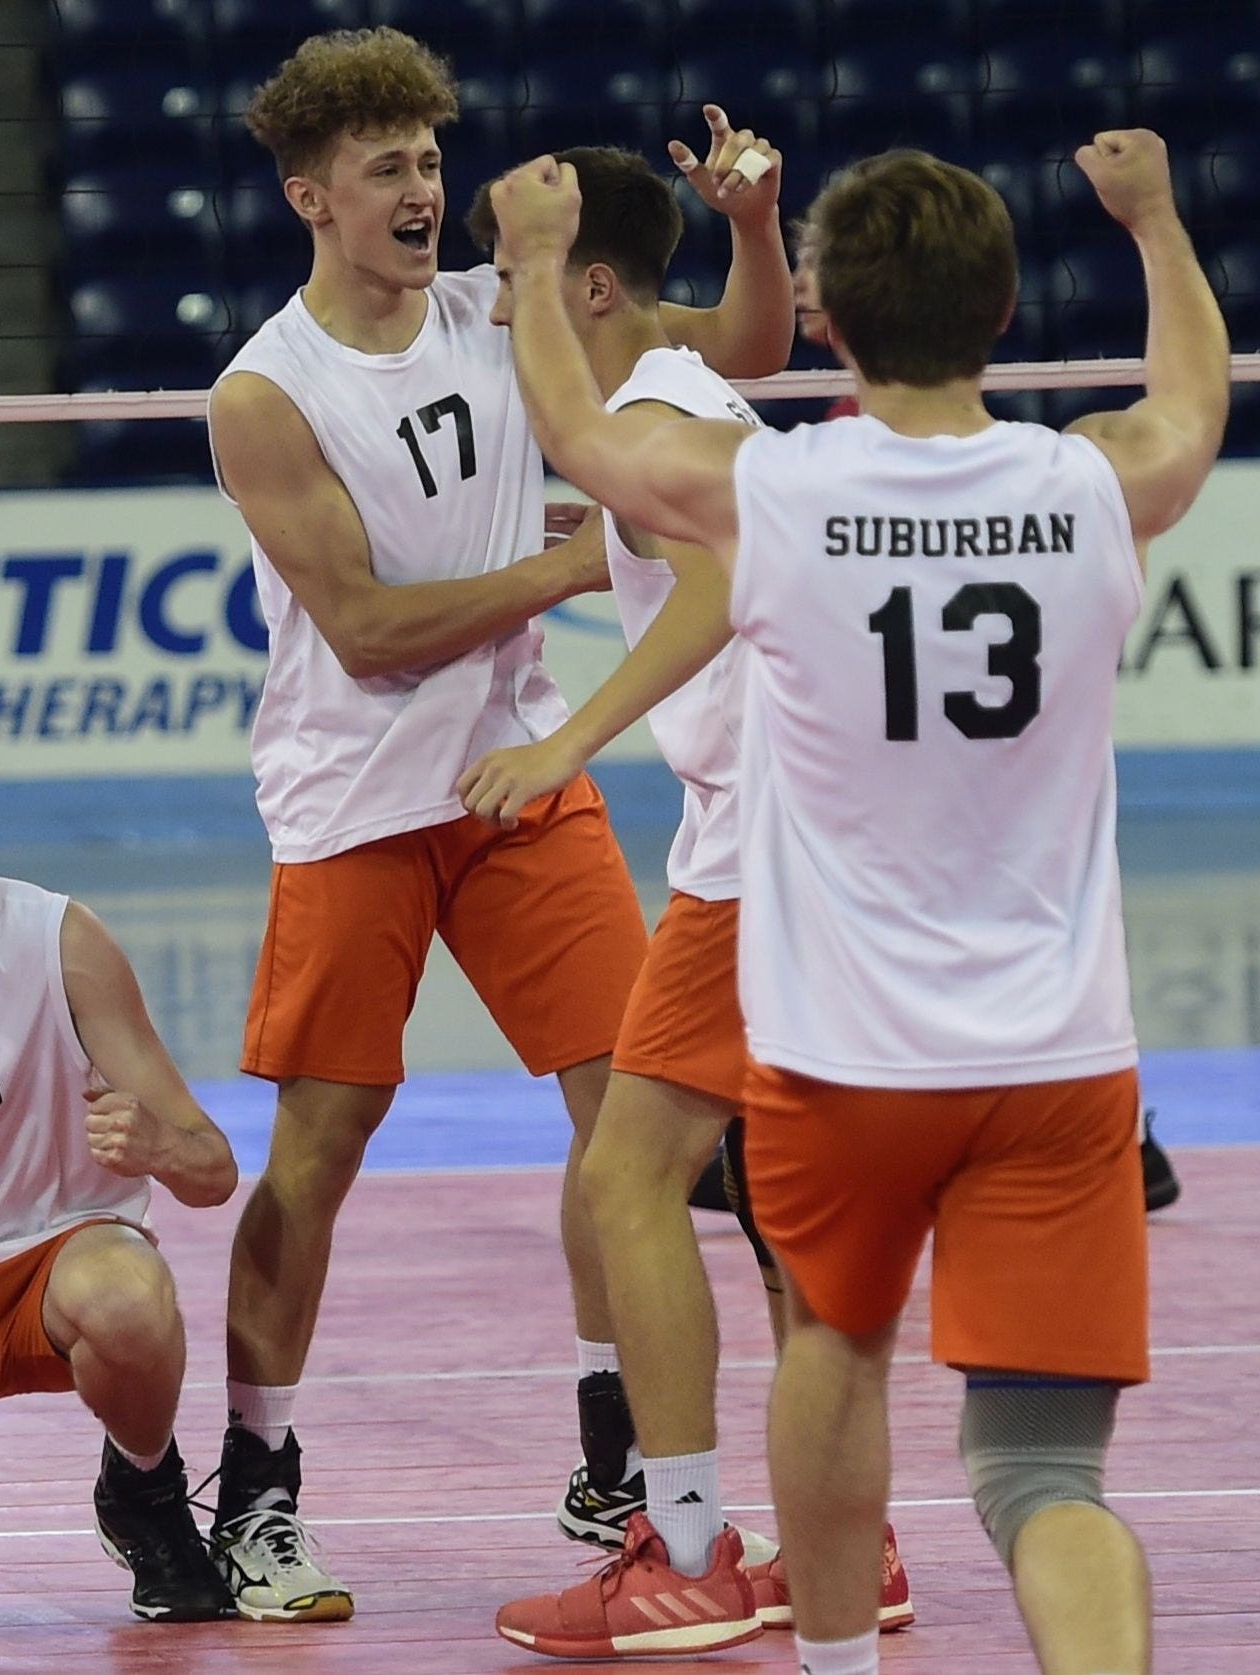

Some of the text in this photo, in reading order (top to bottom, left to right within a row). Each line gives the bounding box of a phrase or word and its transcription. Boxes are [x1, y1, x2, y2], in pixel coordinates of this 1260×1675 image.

[396, 392, 477, 499] 17
[825, 513, 1076, 558] SUBURBAN
[868, 581, 1042, 742] 13
